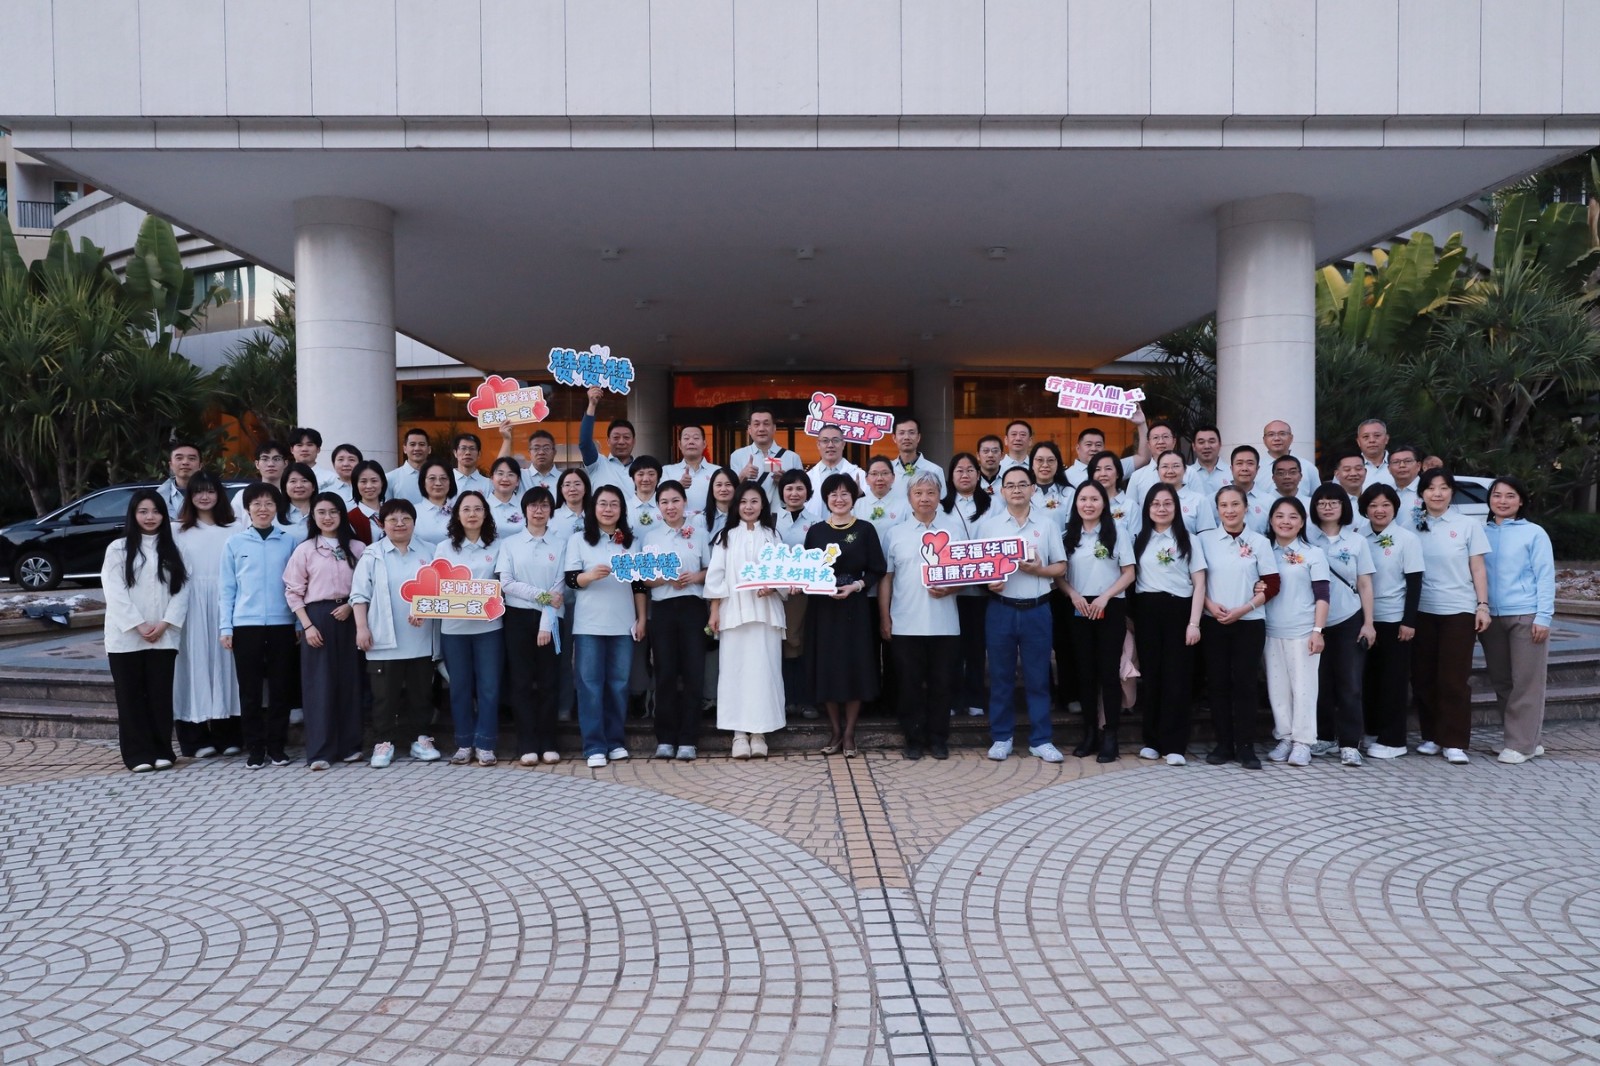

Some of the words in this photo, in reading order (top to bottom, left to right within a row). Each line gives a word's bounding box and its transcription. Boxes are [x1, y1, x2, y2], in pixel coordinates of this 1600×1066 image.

[551, 350, 634, 393] 赞赞赞
[1048, 378, 1120, 400] 疗养暖人心
[483, 406, 532, 424] 幸福一家
[1060, 395, 1134, 416] 蓄力向前行
[833, 408, 888, 427] 幸福华师
[760, 545, 821, 563] 疗养身心
[950, 540, 1018, 561] 幸福华师
[611, 552, 681, 580] 赞赞赞
[740, 564, 835, 583] 共享美好时光
[928, 561, 995, 582] 健康疗养
[441, 580, 497, 596] 华师我家
[416, 598, 483, 615] 幸福一家
